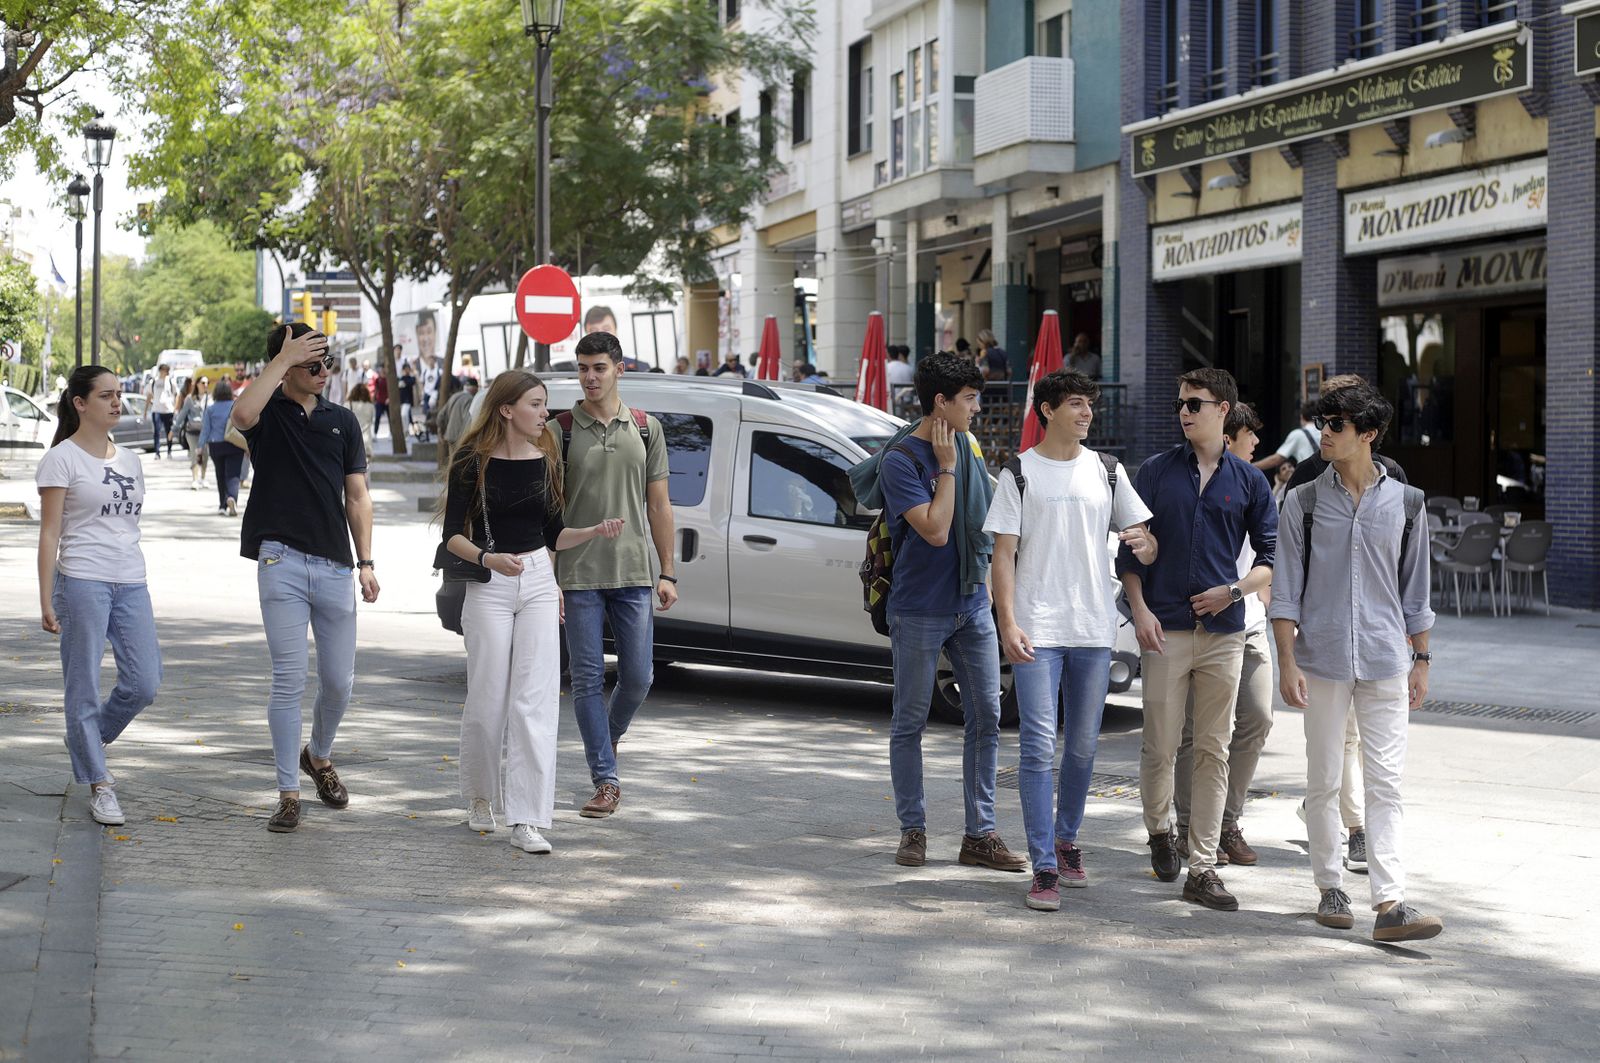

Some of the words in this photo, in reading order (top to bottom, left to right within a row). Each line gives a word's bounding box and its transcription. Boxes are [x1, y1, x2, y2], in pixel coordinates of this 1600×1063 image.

[1245, 109, 1258, 133] de
[1260, 90, 1334, 133] Especialidades
[1333, 95, 1345, 119] y
[1345, 76, 1405, 108] Medicina
[1407, 62, 1463, 93] Estética
[1358, 180, 1501, 242] MONTADITOS
[1163, 220, 1269, 270] MONTADITOS
[1456, 247, 1547, 290] MONT
